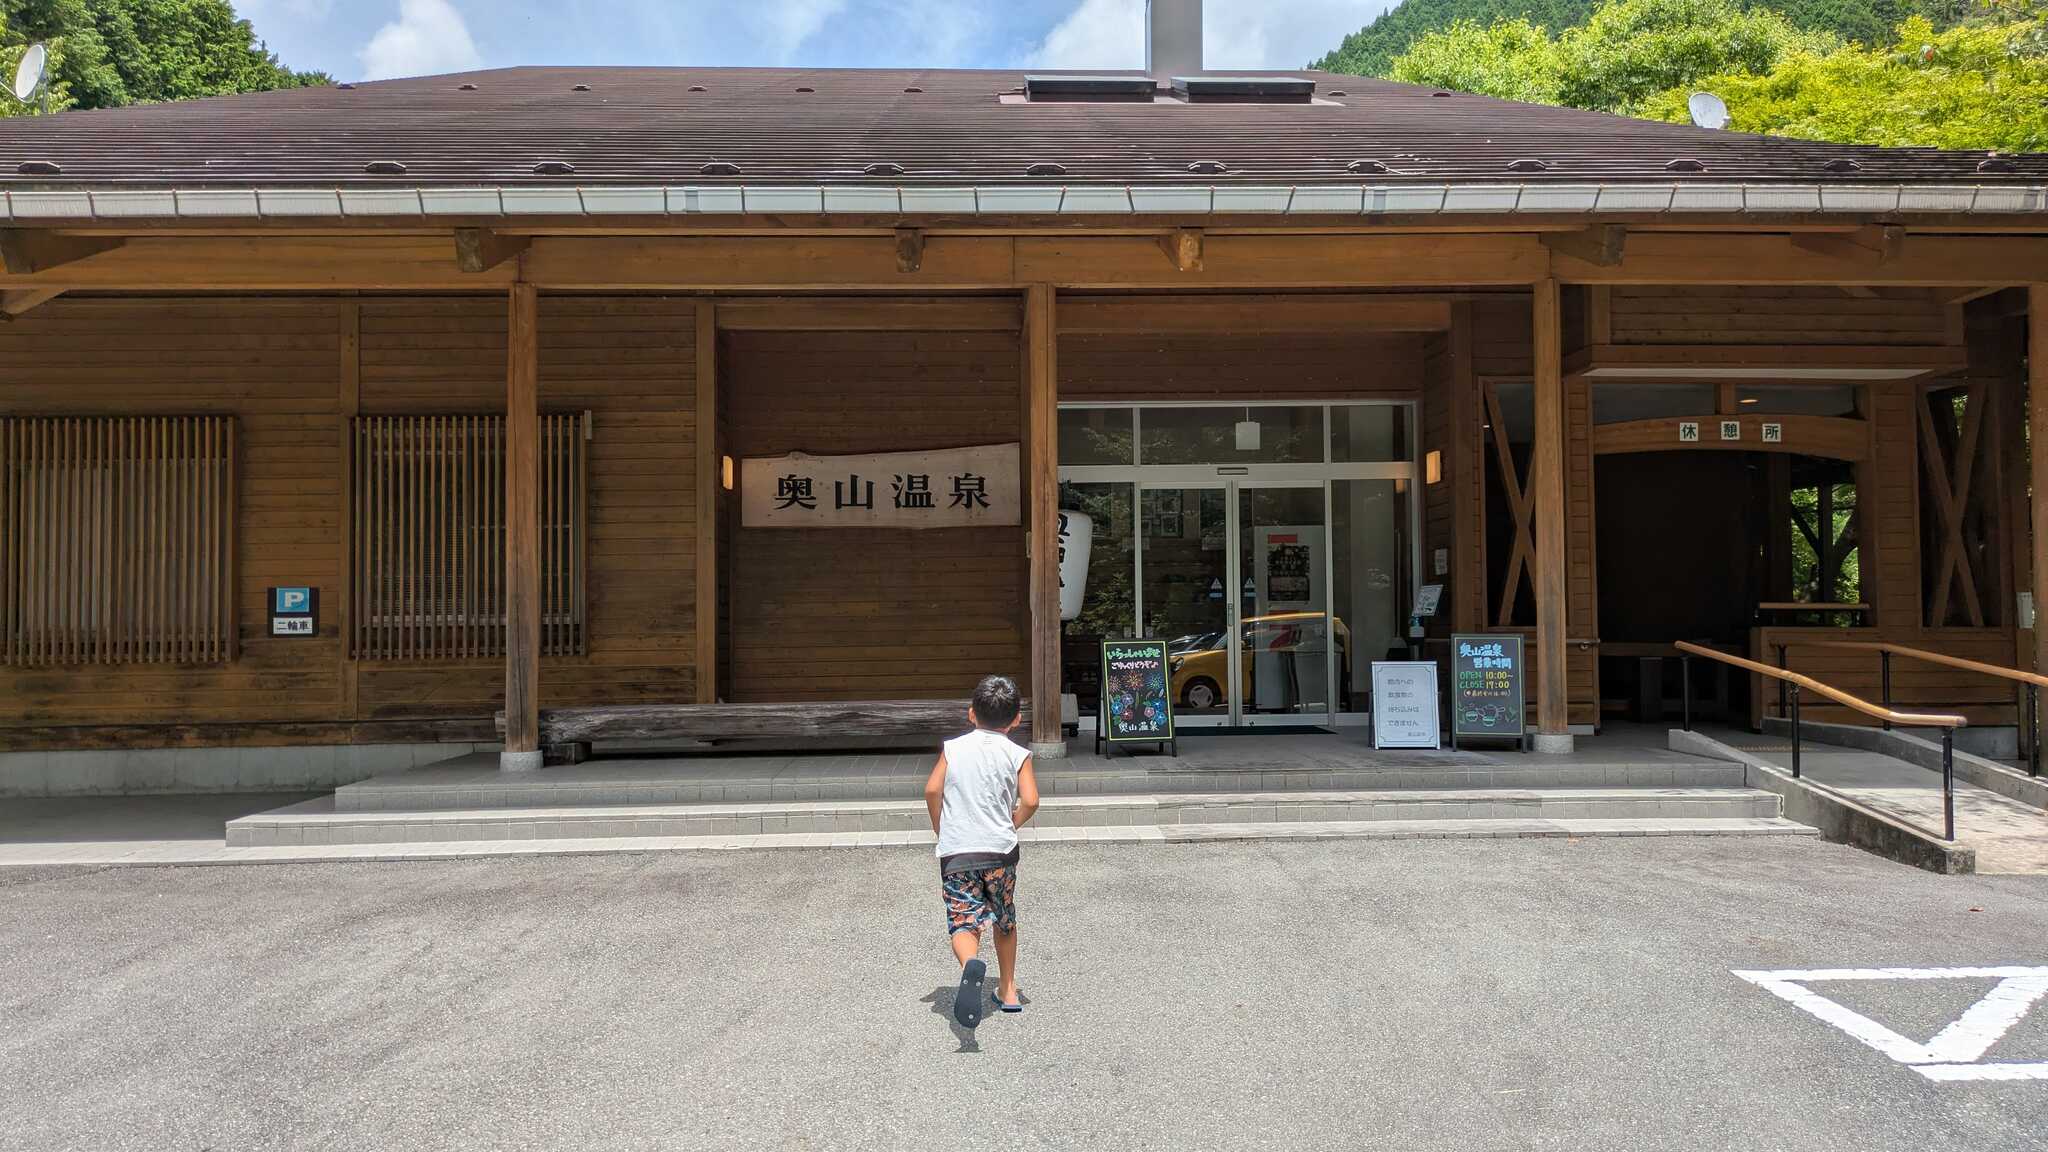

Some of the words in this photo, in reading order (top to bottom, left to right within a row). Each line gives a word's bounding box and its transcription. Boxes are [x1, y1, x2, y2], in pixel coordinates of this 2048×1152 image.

[1681, 423, 1780, 440] 休憩所
[774, 472, 991, 511] 奥山温泉
[284, 591, 304, 608] P
[276, 620, 310, 631] 二輪車
[1106, 647, 1161, 660] いらっしゃいませ
[1459, 642, 1504, 657] 奥山温泉
[1472, 657, 1512, 669] 営業時間
[1459, 671, 1482, 680] OPEN
[1459, 680, 1485, 689] CLOSE
[1485, 680, 1510, 690] 17:00
[1118, 720, 1160, 733] 奥山温泉
